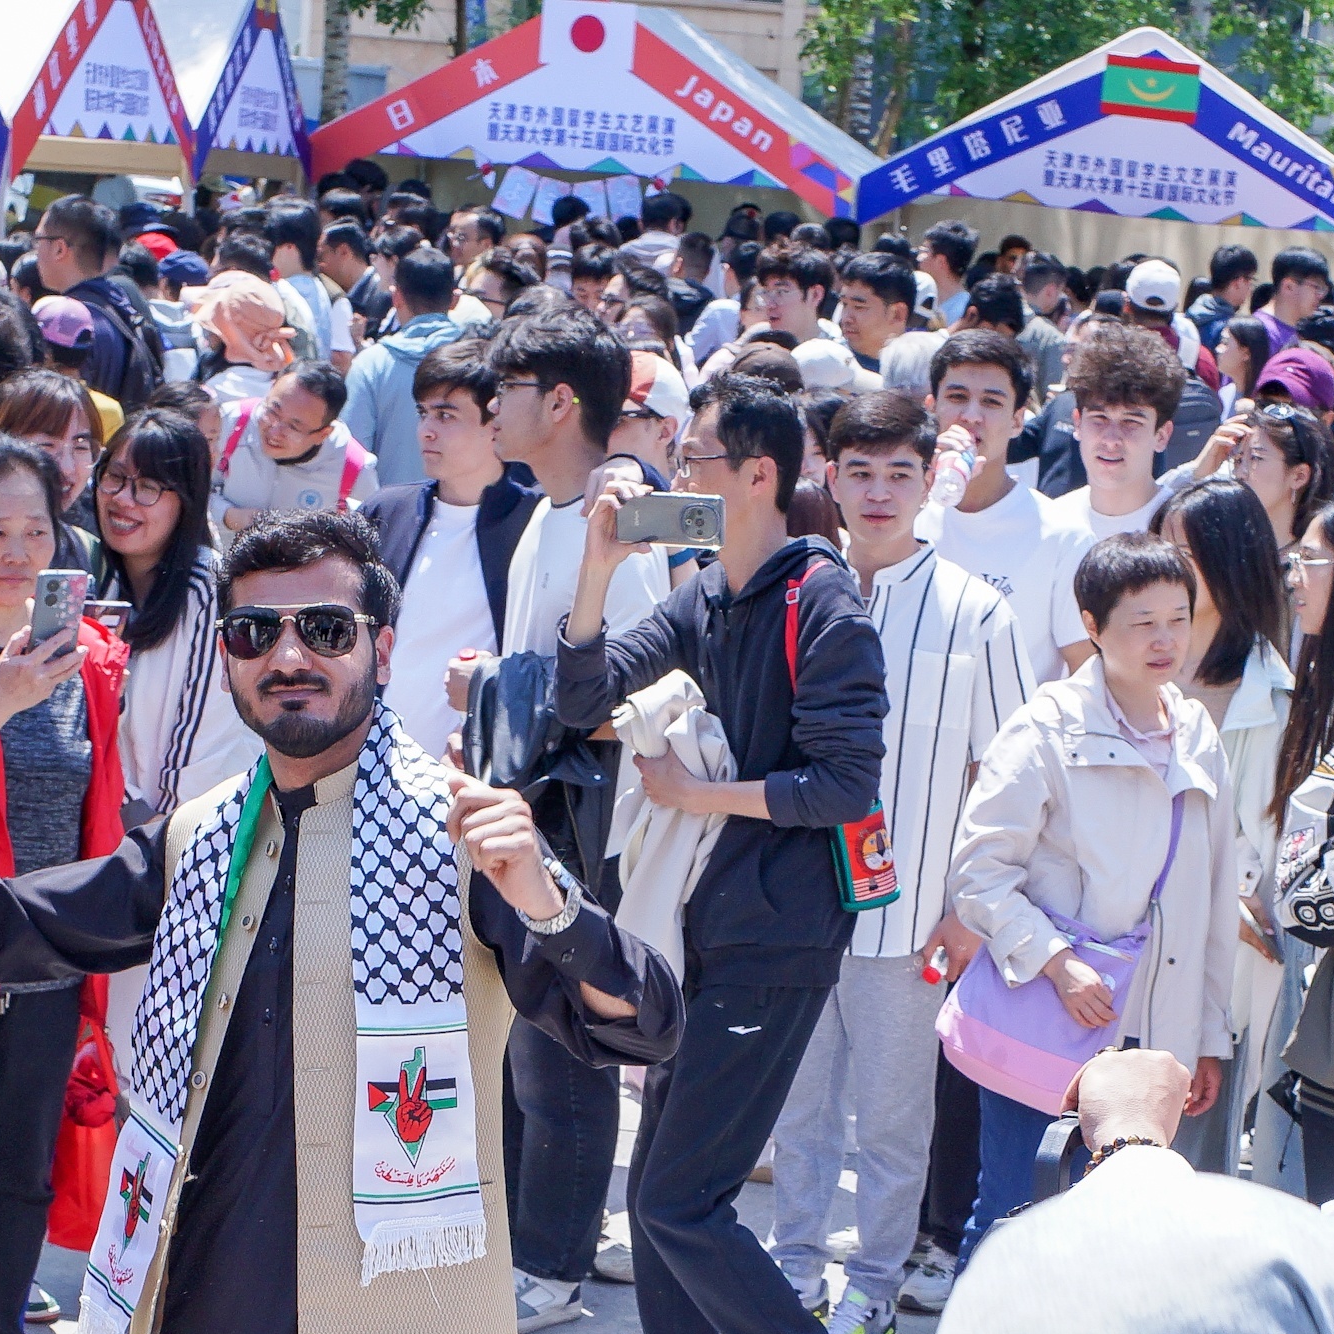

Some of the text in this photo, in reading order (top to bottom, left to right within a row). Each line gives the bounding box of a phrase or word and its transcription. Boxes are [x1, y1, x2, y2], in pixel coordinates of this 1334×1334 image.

[385, 57, 499, 132] 日本
[676, 74, 775, 153] Japan
[889, 98, 1068, 194] 毛里塔尼亚
